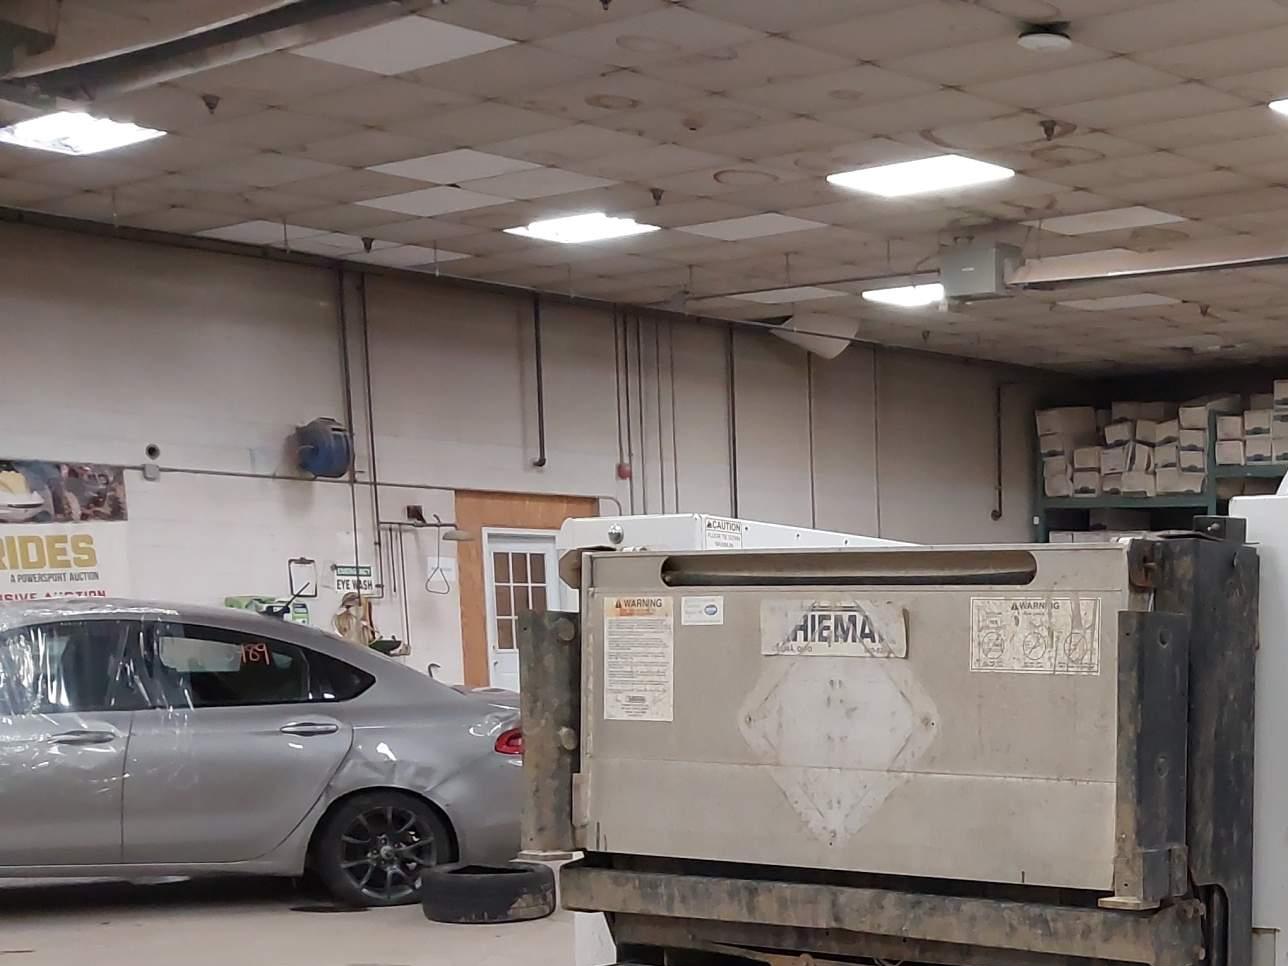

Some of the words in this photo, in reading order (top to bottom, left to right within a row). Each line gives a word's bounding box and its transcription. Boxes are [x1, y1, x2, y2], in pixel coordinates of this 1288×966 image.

[712, 520, 741, 532] CAUTION
[10, 574, 16, 583] A
[17, 573, 67, 582] POWERSPORT
[69, 571, 99, 581] AUCTION
[336, 579, 350, 590] EYE
[352, 579, 373, 590] WASH
[624, 598, 662, 608] WARNING
[1020, 601, 1060, 610] WARNG
